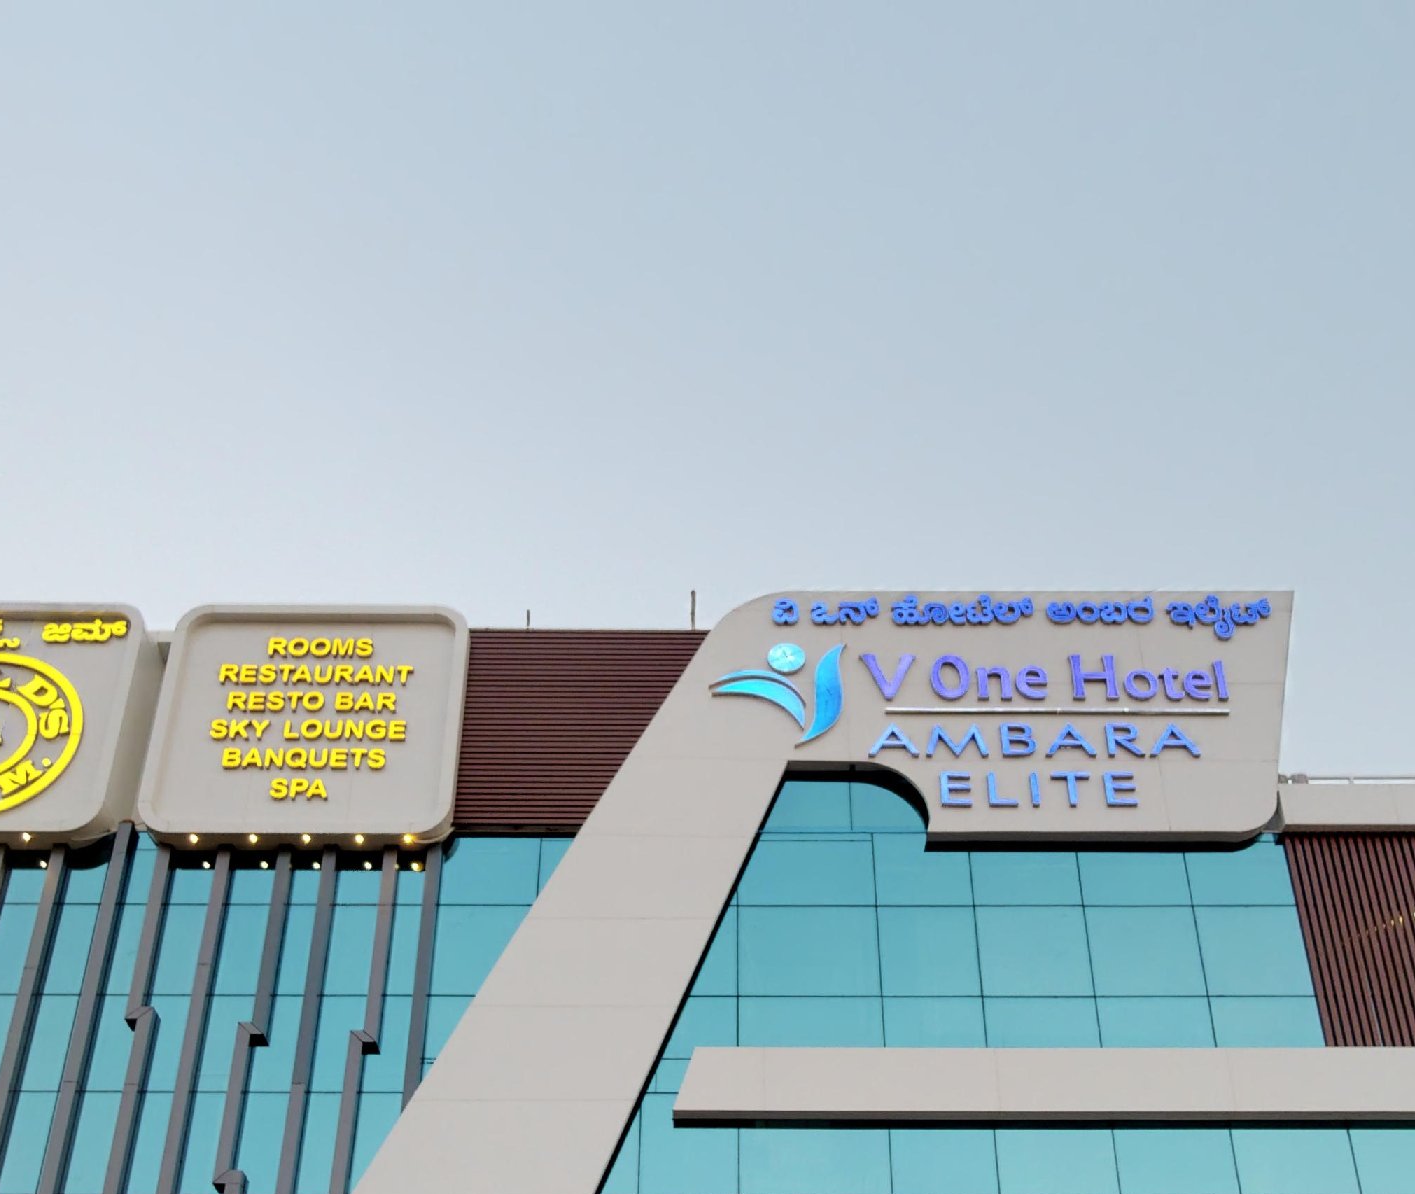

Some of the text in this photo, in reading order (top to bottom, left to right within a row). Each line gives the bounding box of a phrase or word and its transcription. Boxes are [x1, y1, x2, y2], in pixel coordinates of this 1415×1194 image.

[771, 596, 800, 626] ವಿ
[810, 596, 880, 626] ಒನ್
[891, 593, 1034, 626] ಹೋಟೆಲ್
[1045, 596, 1155, 625] ಅಂಬರ
[267, 636, 375, 658] ROOMS
[218, 663, 414, 685] RESTAURANT
[858, 653, 1230, 702] V One Hotel
[226, 690, 398, 713] RESTO BAR
[209, 718, 408, 741] SKY LOUNGE
[868, 721, 1202, 758] AMBARA
[221, 746, 387, 770] BANQUETS
[269, 777, 328, 800] SPA
[939, 769, 1139, 808] ELITE
